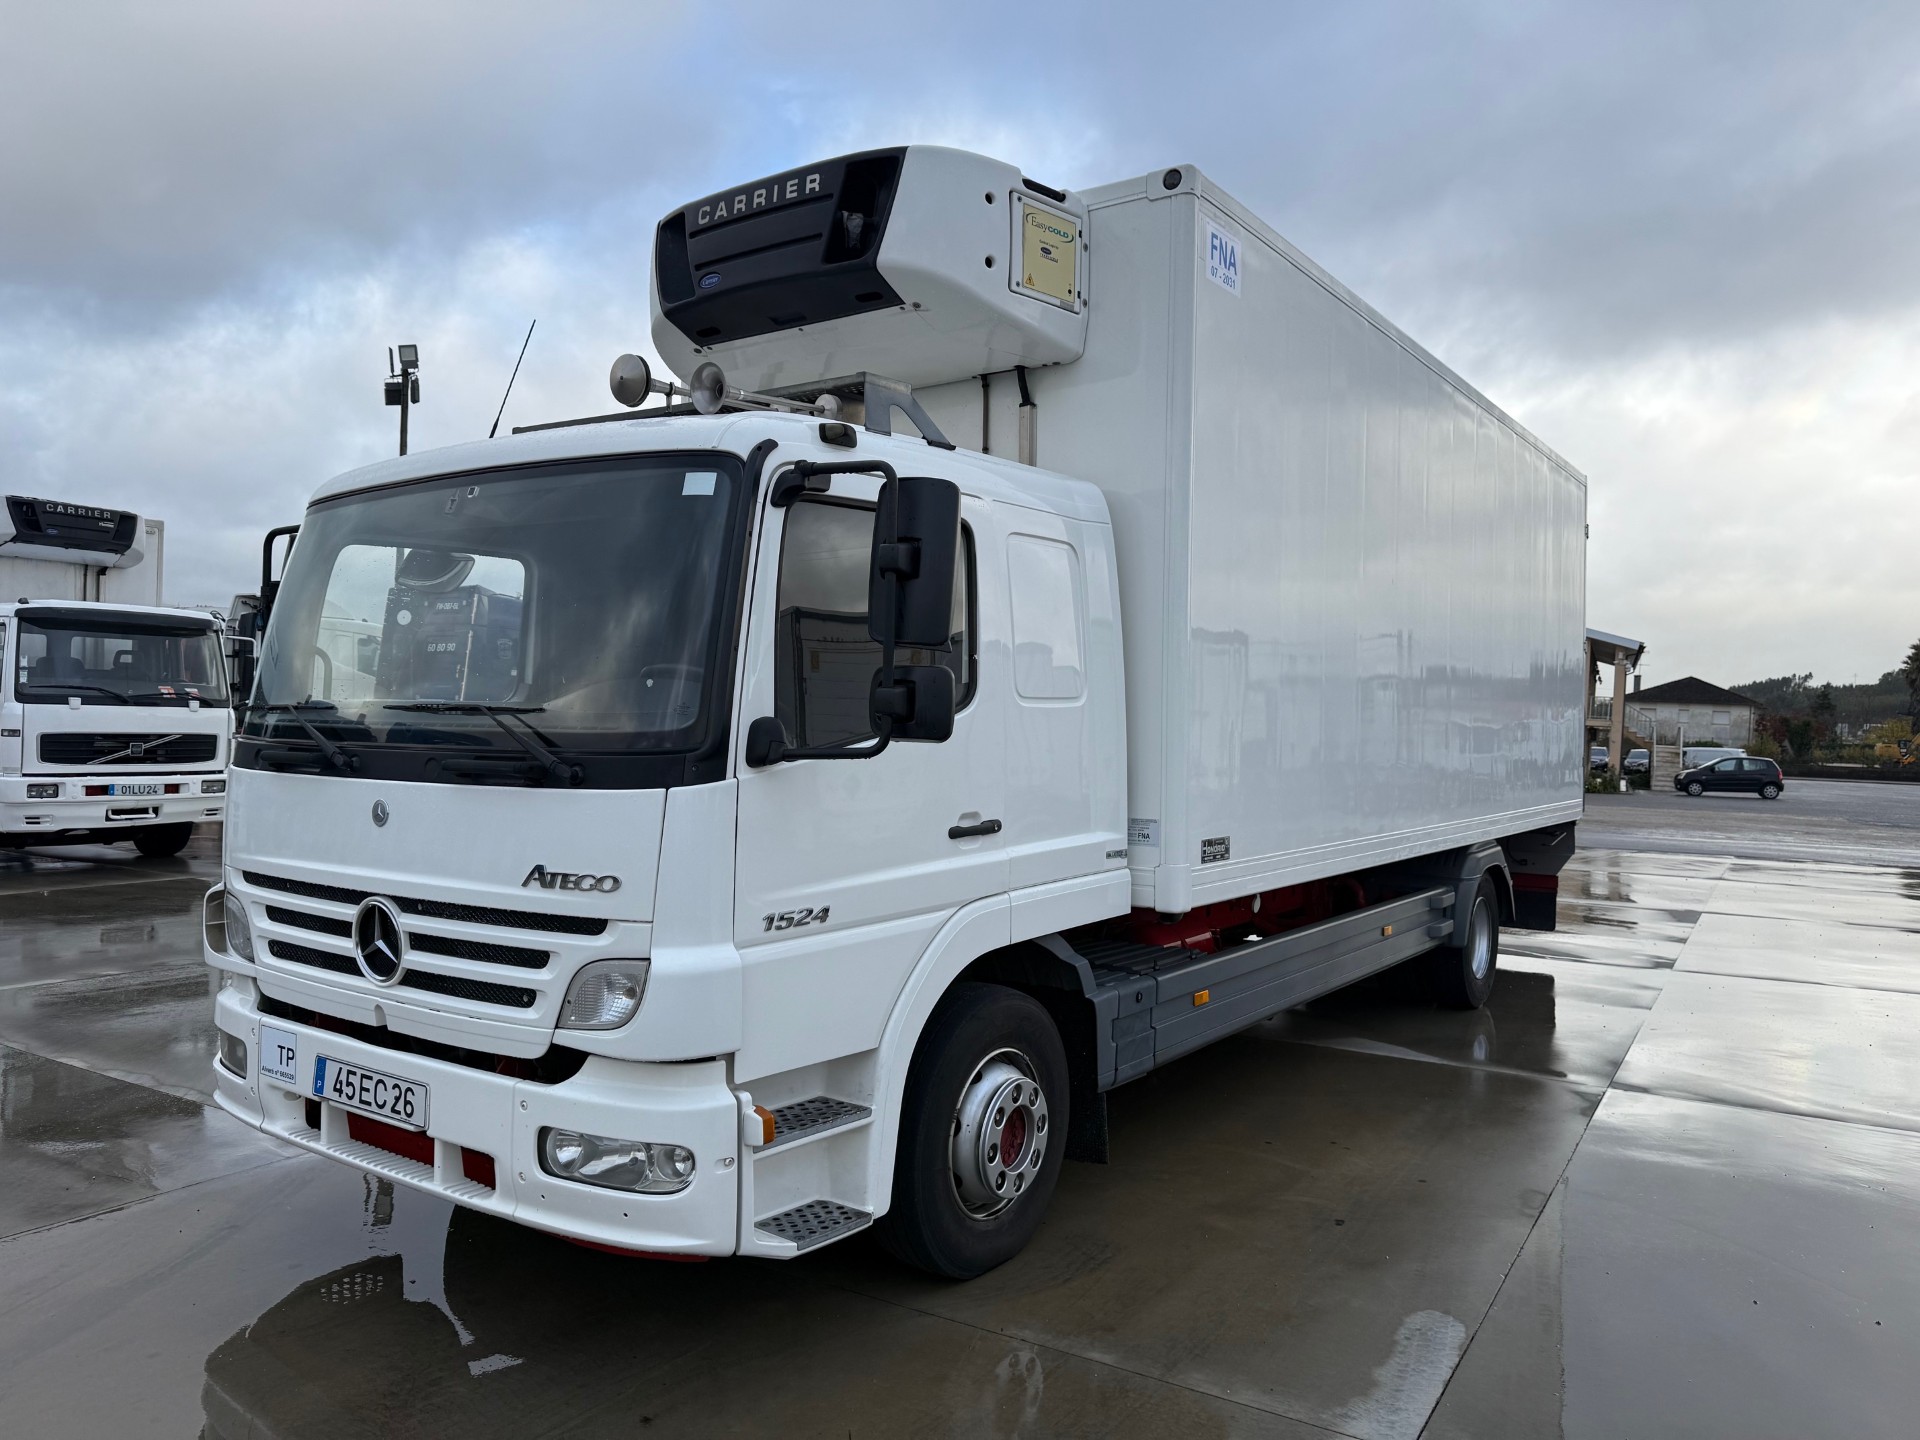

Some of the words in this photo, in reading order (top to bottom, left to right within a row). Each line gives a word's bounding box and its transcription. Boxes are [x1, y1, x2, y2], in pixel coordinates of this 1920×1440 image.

[698, 173, 820, 225] CARRIER
[1211, 232, 1237, 276] FNA
[1211, 265, 1218, 278] 07
[1222, 273, 1236, 290] 2031
[46, 503, 111, 519] CARRIER
[121, 785, 158, 794] 01LU24
[1137, 832, 1151, 840] FNA
[762, 905, 830, 932] 1524
[277, 1044, 295, 1067] TP
[316, 1080, 322, 1088] P
[332, 1066, 416, 1119] 45EC26
